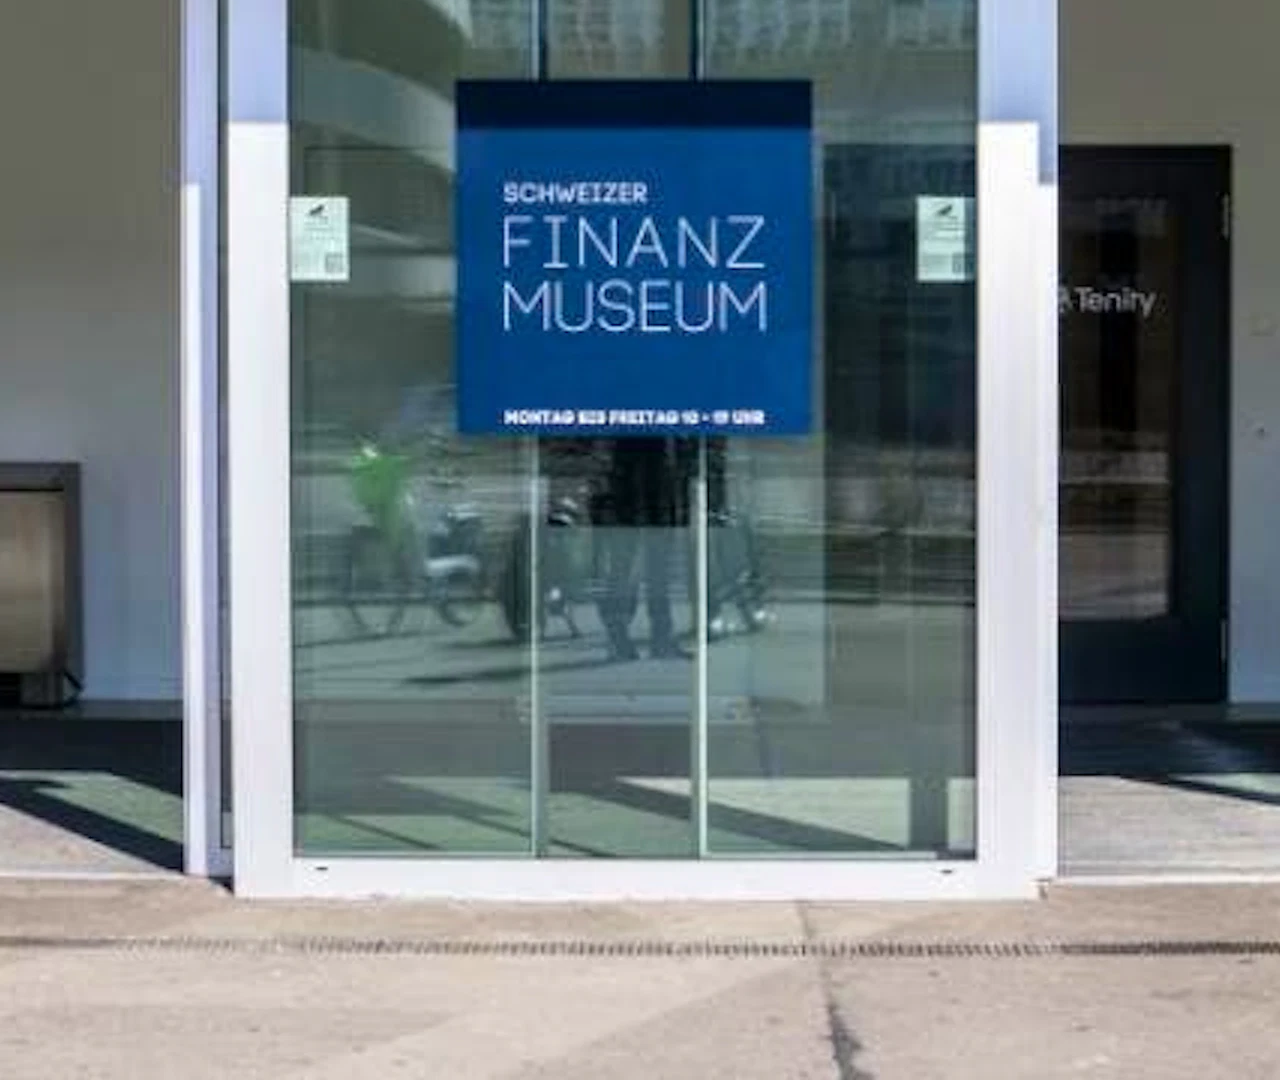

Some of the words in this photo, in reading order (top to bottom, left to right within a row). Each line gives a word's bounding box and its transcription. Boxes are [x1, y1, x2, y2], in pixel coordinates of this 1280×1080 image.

[502, 181, 649, 204] SCHWEIZER
[503, 216, 766, 269] FINANZ
[503, 279, 768, 333] MUSEUM
[1073, 286, 1158, 318] Tenity
[503, 409, 576, 425] MONTAG
[609, 409, 679, 425] FREITAG
[732, 409, 766, 425] UHR
